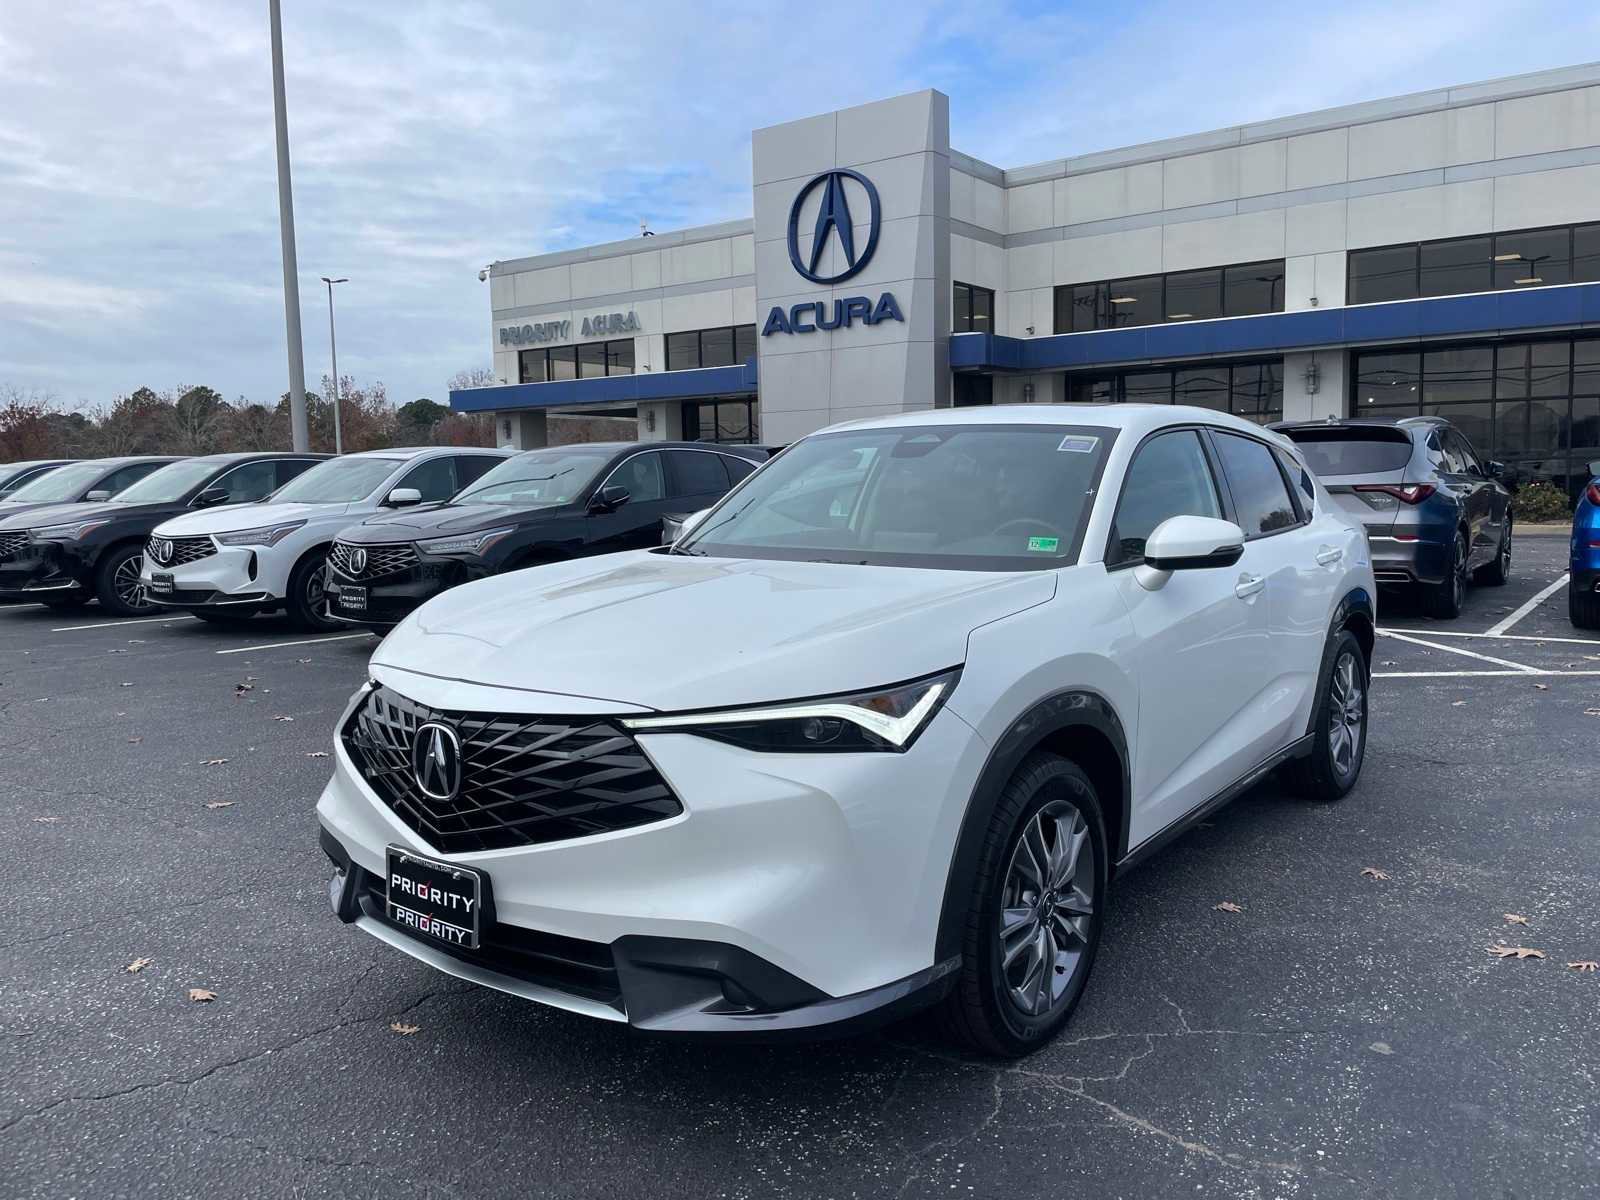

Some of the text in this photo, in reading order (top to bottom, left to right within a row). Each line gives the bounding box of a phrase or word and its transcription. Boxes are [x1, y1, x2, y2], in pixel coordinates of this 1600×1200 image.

[499, 311, 641, 346] PRIORITY ACURA
[761, 292, 904, 336] ACURA
[391, 873, 474, 913] PRIORITY
[396, 907, 466, 944] PRIORITY
